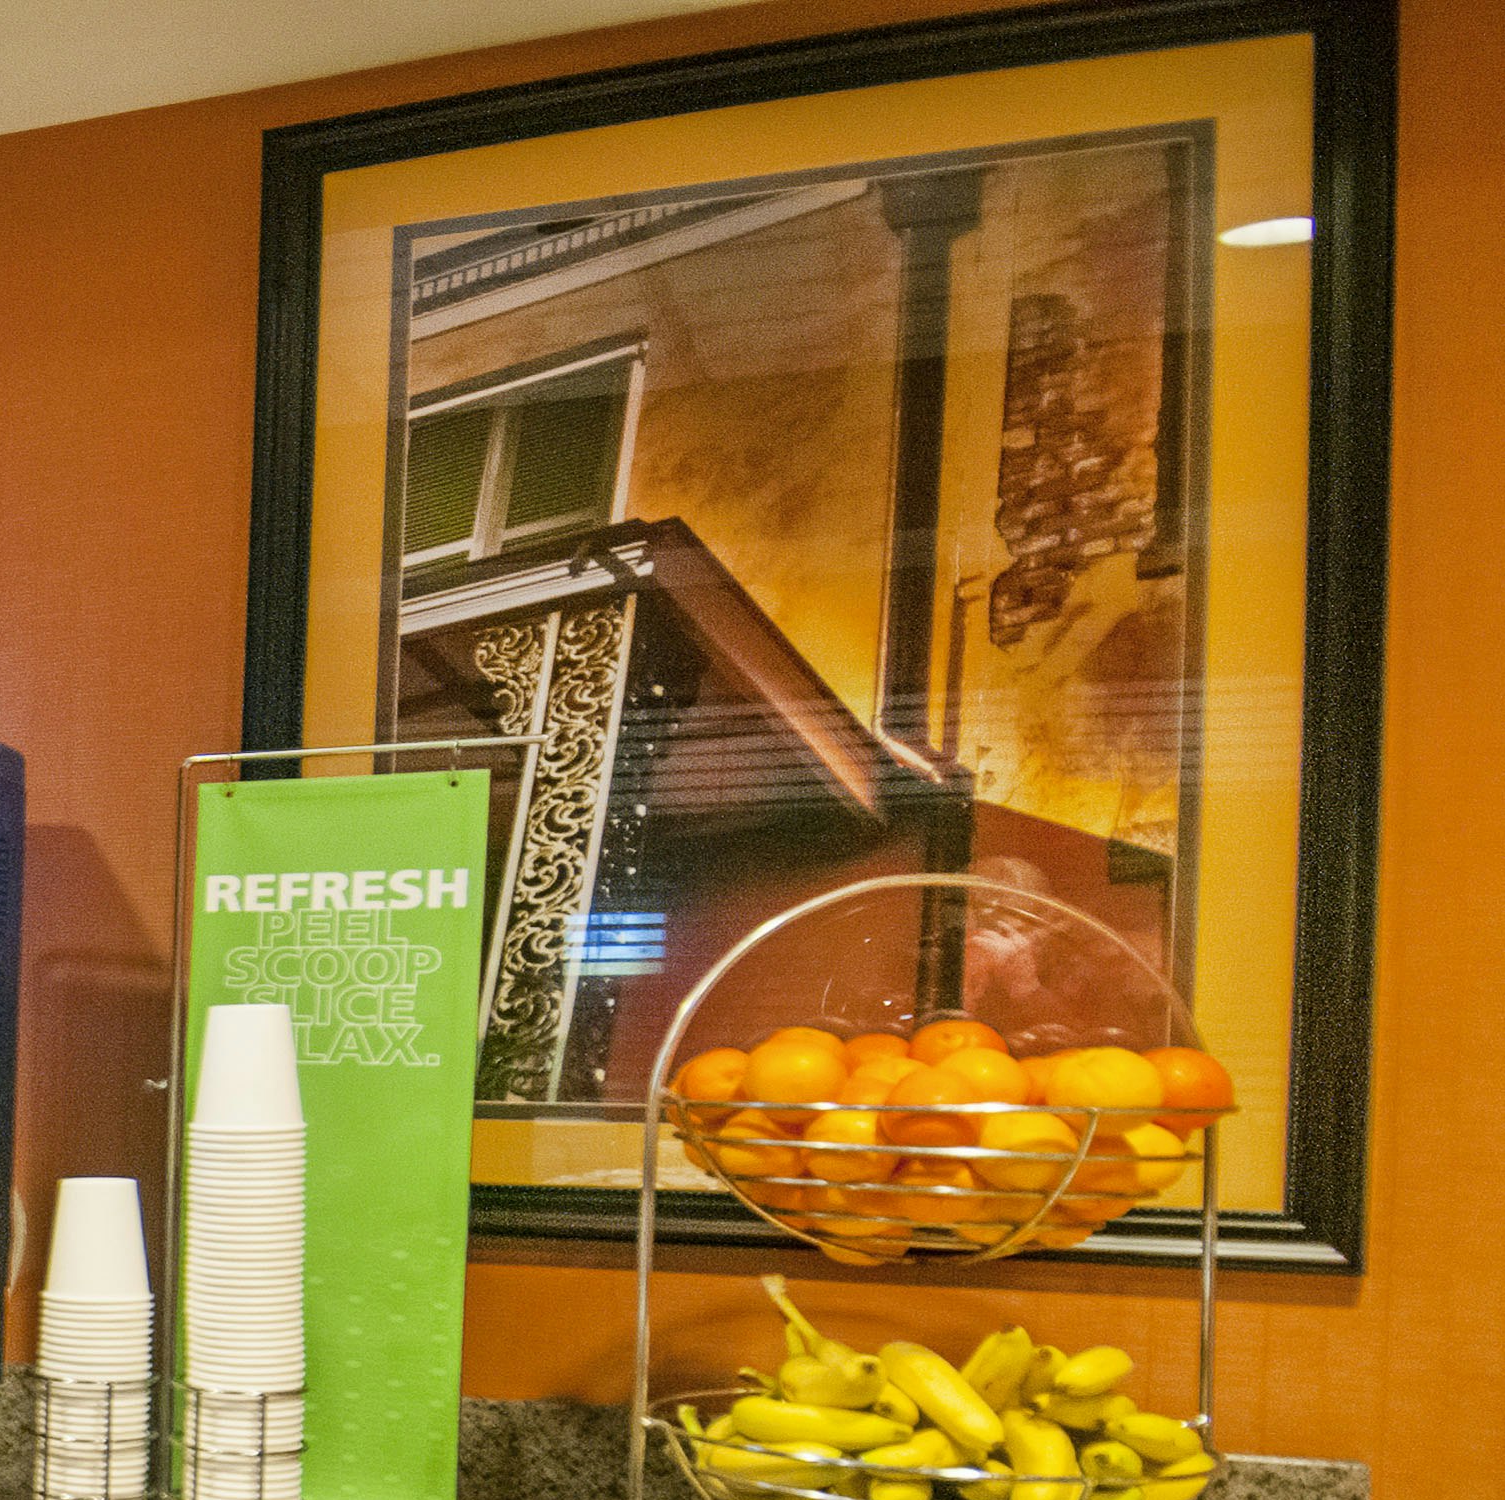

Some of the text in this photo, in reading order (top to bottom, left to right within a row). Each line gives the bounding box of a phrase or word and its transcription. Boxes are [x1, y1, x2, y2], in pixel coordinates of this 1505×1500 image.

[205, 867, 469, 913] REFRESH
[259, 907, 408, 949] PEEL
[225, 945, 442, 987] SCOOP
[293, 1023, 441, 1066] LAX.
